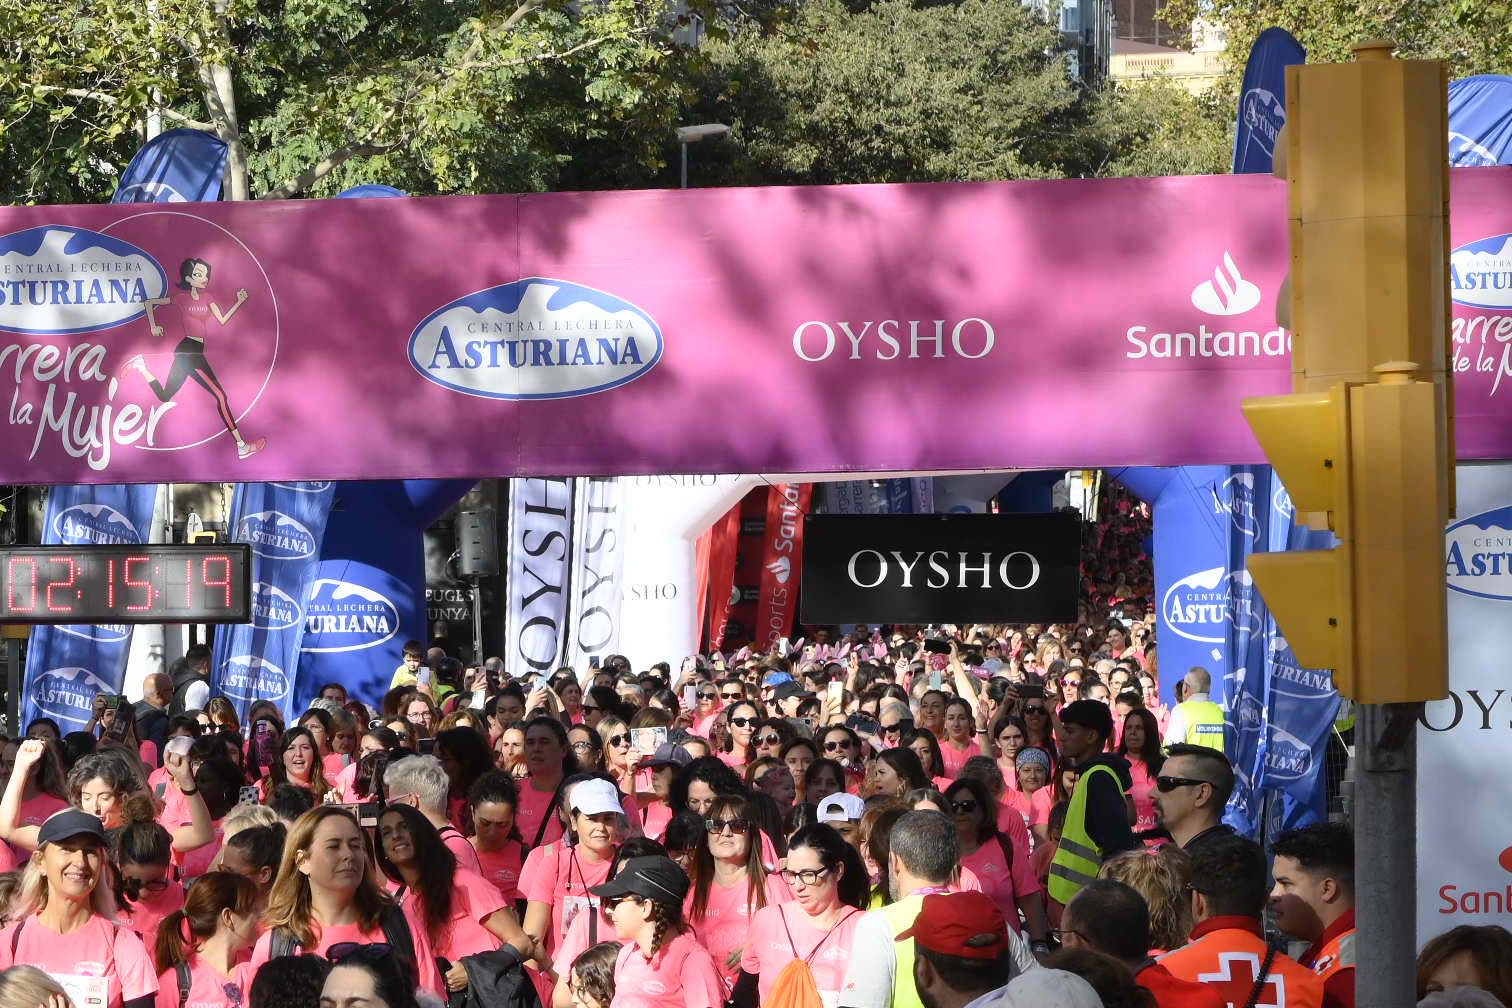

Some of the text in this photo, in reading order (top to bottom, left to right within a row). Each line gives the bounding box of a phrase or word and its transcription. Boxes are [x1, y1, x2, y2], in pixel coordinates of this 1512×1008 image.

[70, 262, 143, 273] LECHERA
[427, 326, 645, 369] ASTURIANA
[467, 319, 635, 334] CENTRAL LECHERA
[792, 318, 995, 362] OYSHO
[1125, 325, 1291, 359] Santand
[8, 398, 34, 425] la
[29, 377, 178, 471] Mujer
[517, 478, 568, 671] OYSH
[579, 477, 617, 653] OYSH
[848, 549, 1041, 590] OYSHO
[336, 603, 386, 613] LECHERA
[1272, 663, 1332, 691] URIANA
[1417, 689, 1512, 732] OY
